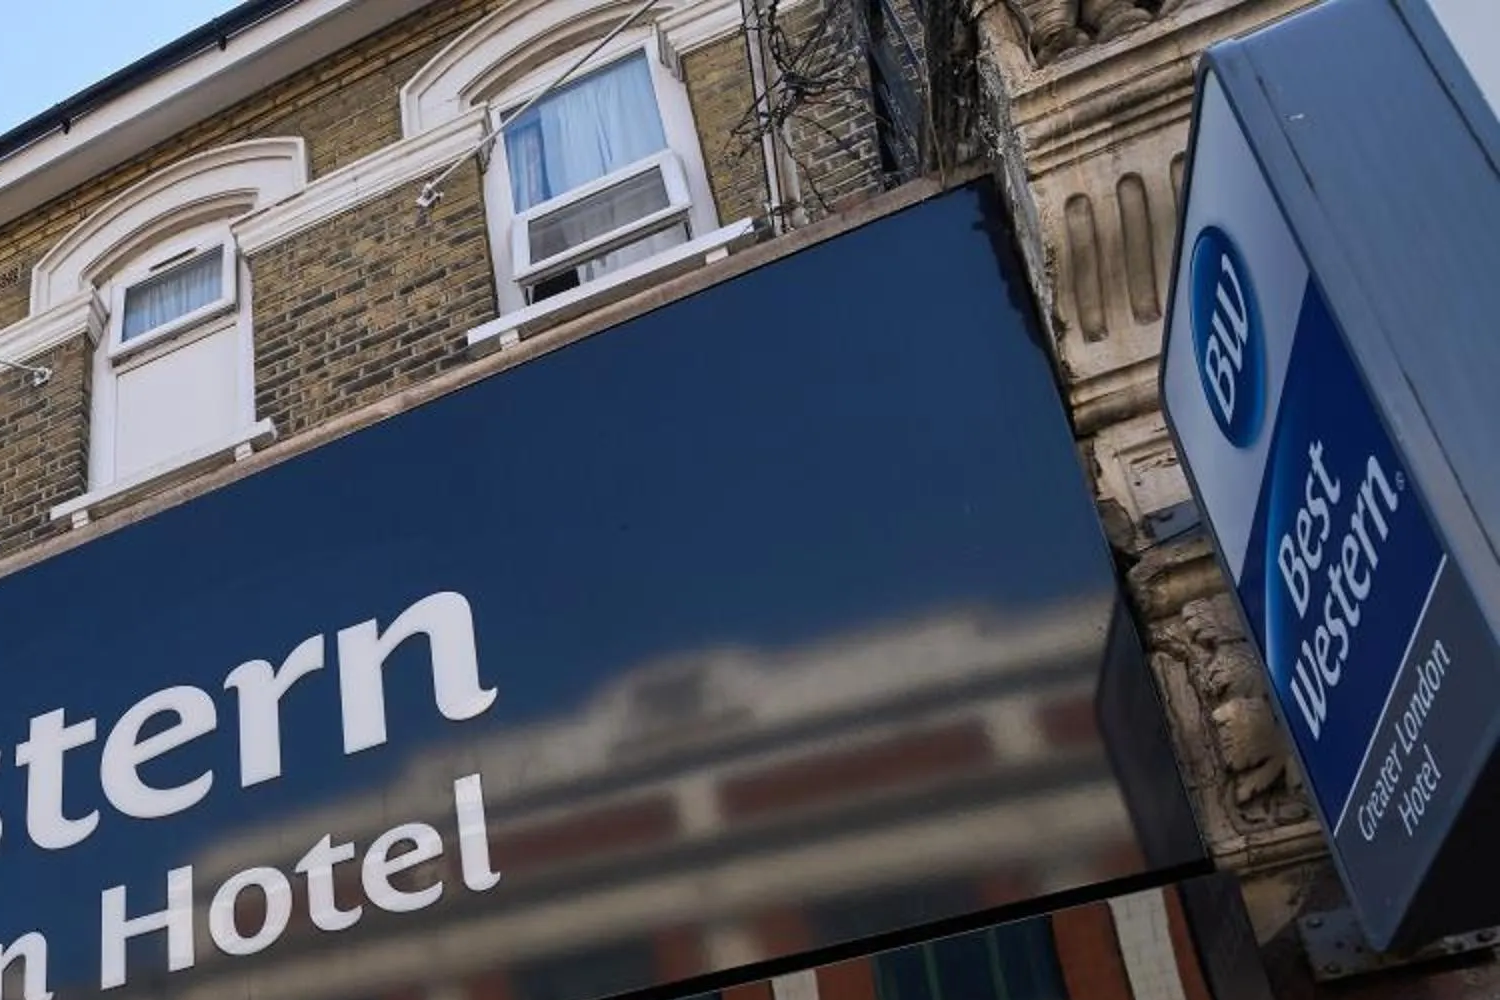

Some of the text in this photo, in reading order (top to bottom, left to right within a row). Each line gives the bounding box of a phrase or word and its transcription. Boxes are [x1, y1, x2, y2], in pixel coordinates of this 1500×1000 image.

[1205, 253, 1248, 425] BW
[1278, 439, 1341, 619] Best
[1289, 455, 1399, 741] Western
[1357, 639, 1451, 843] Greater London
[1397, 743, 1442, 838] Hotel
[100, 773, 500, 990] Hotel
